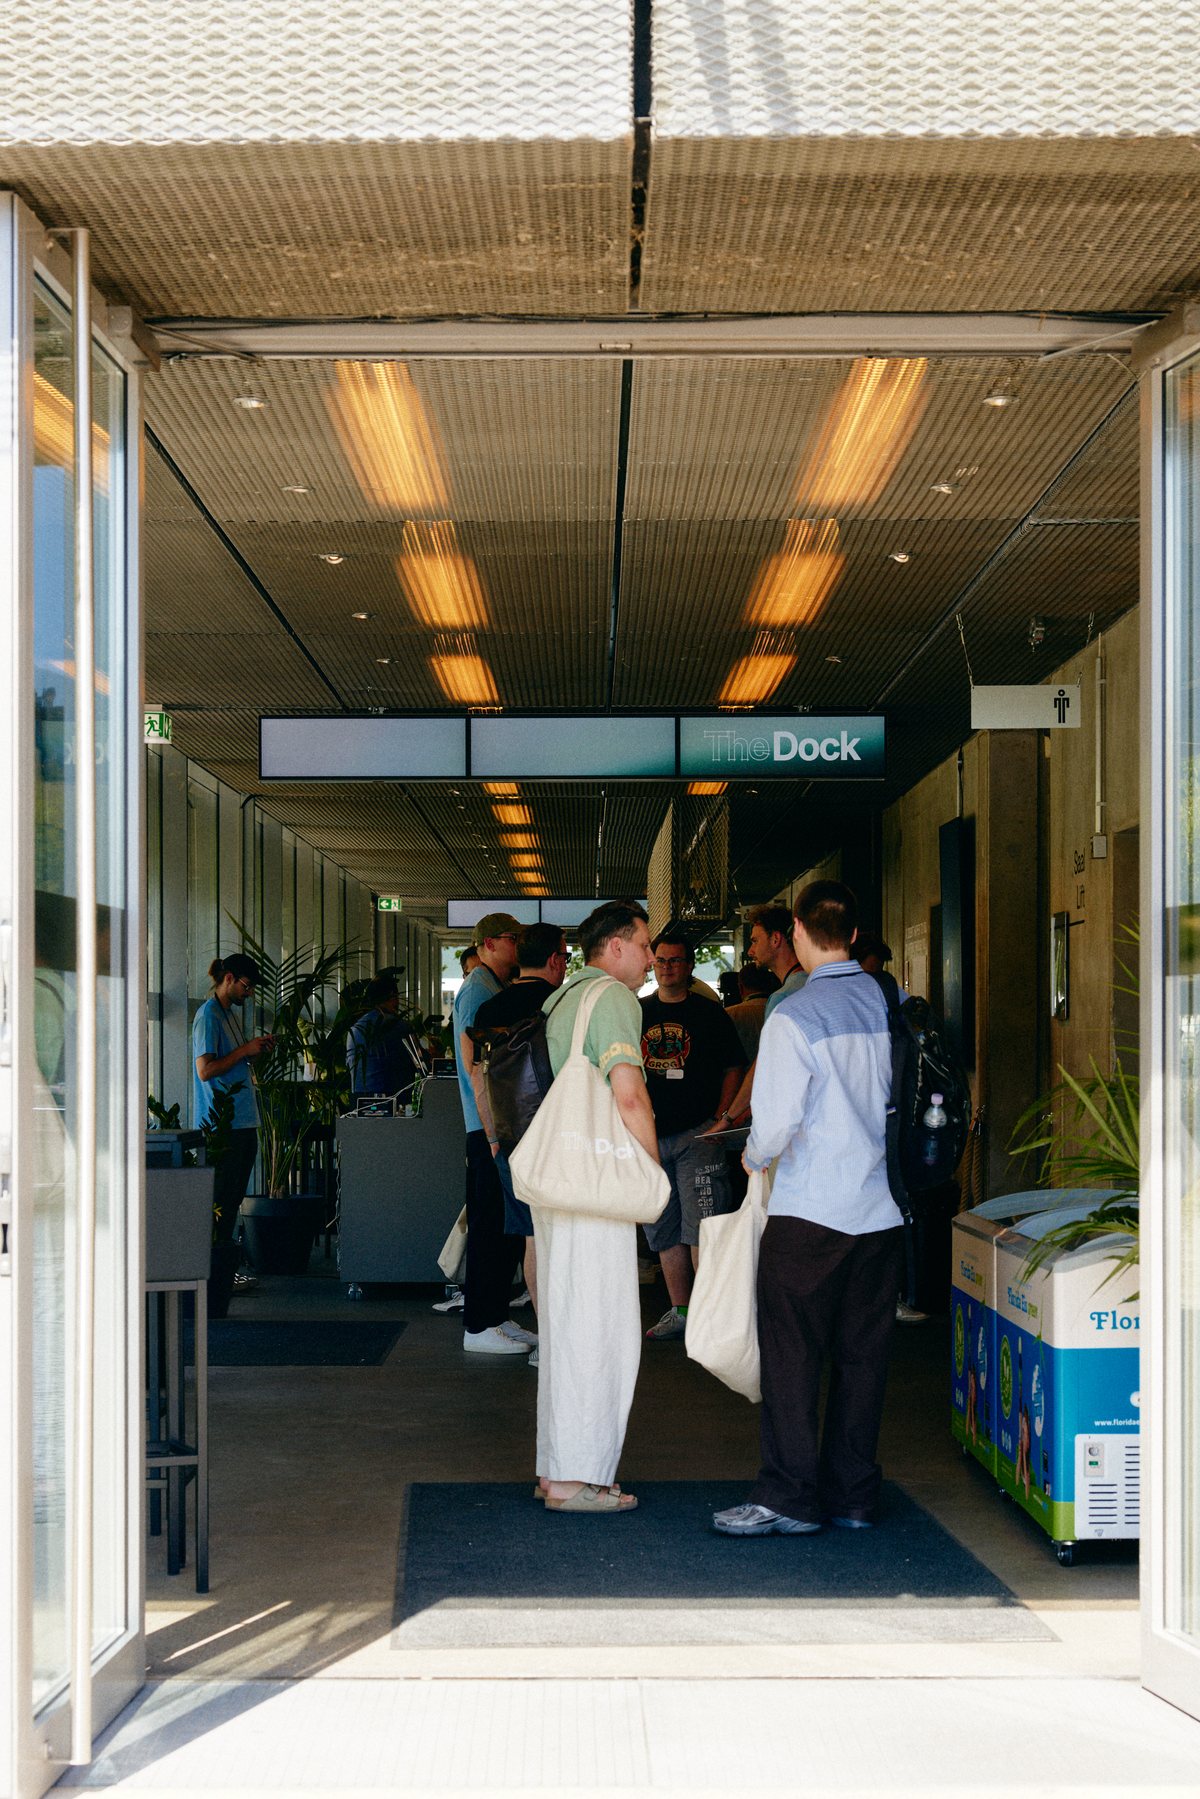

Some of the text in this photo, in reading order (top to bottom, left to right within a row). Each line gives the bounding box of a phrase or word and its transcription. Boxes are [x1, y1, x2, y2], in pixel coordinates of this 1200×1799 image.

[703, 730, 862, 762] The Dock
[648, 1061, 678, 1069] GROG
